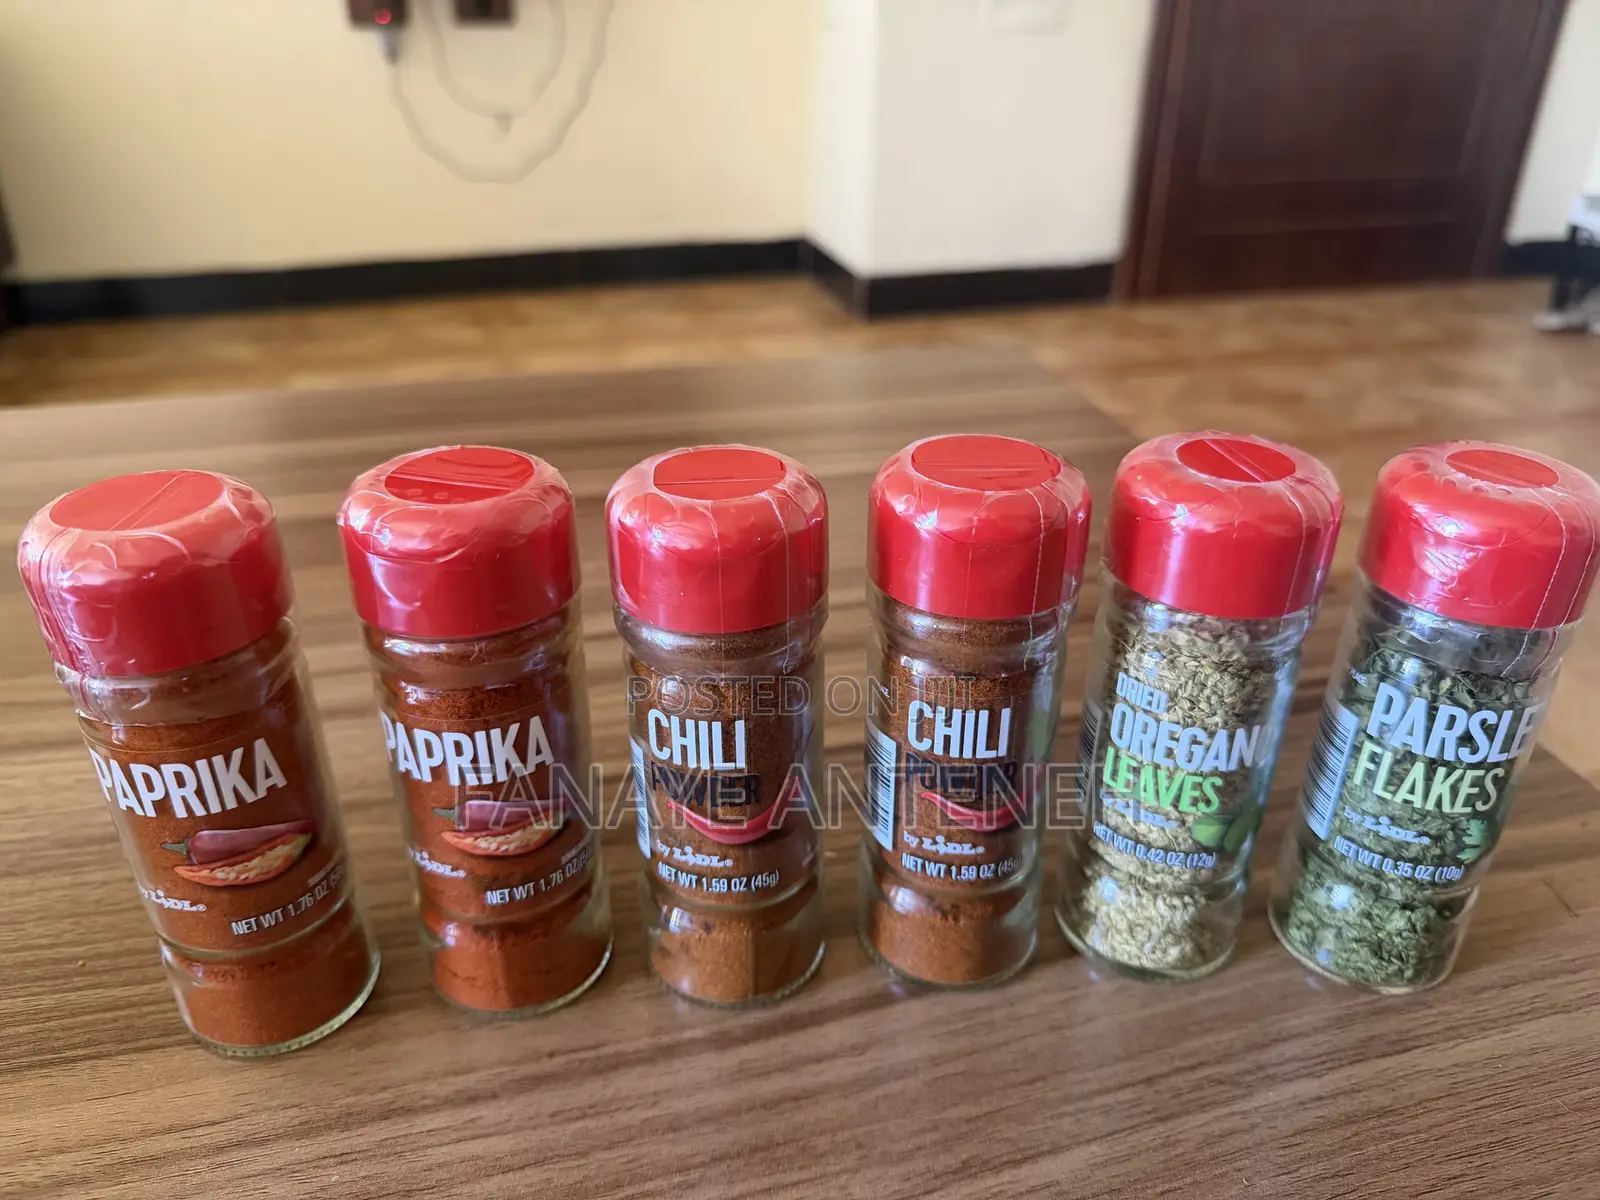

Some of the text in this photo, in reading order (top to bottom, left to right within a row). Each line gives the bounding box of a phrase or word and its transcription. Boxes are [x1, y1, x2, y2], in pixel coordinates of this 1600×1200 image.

[1116, 672, 1168, 714] DRIED
[379, 708, 554, 786] PAPRIKA
[647, 708, 745, 770] CHILI
[907, 700, 1012, 759] CHILI
[1110, 703, 1261, 773] OREGAN
[1366, 682, 1546, 763] PARSLE
[88, 737, 287, 818] PAPRIKA
[1103, 746, 1223, 813] LEAVES
[1353, 740, 1504, 814] FLAKES
[656, 839, 670, 857] by
[902, 853, 924, 876] NET
[925, 862, 947, 879] WT
[950, 865, 975, 881] 1.59
[980, 863, 995, 878] OZ
[903, 831, 919, 849] by
[1093, 820, 1216, 870] NET WT 0.42 OZ (12g)
[1333, 835, 1465, 883] NET WT 0.35 OZ (10g)
[486, 889, 511, 905] NET
[513, 882, 536, 900] WT
[539, 869, 564, 892] 1.76
[566, 857, 579, 877] OZ
[658, 861, 780, 893] NET WT 1.59 OZ (45g)
[231, 879, 330, 936] NET WT 1.76 OZ
